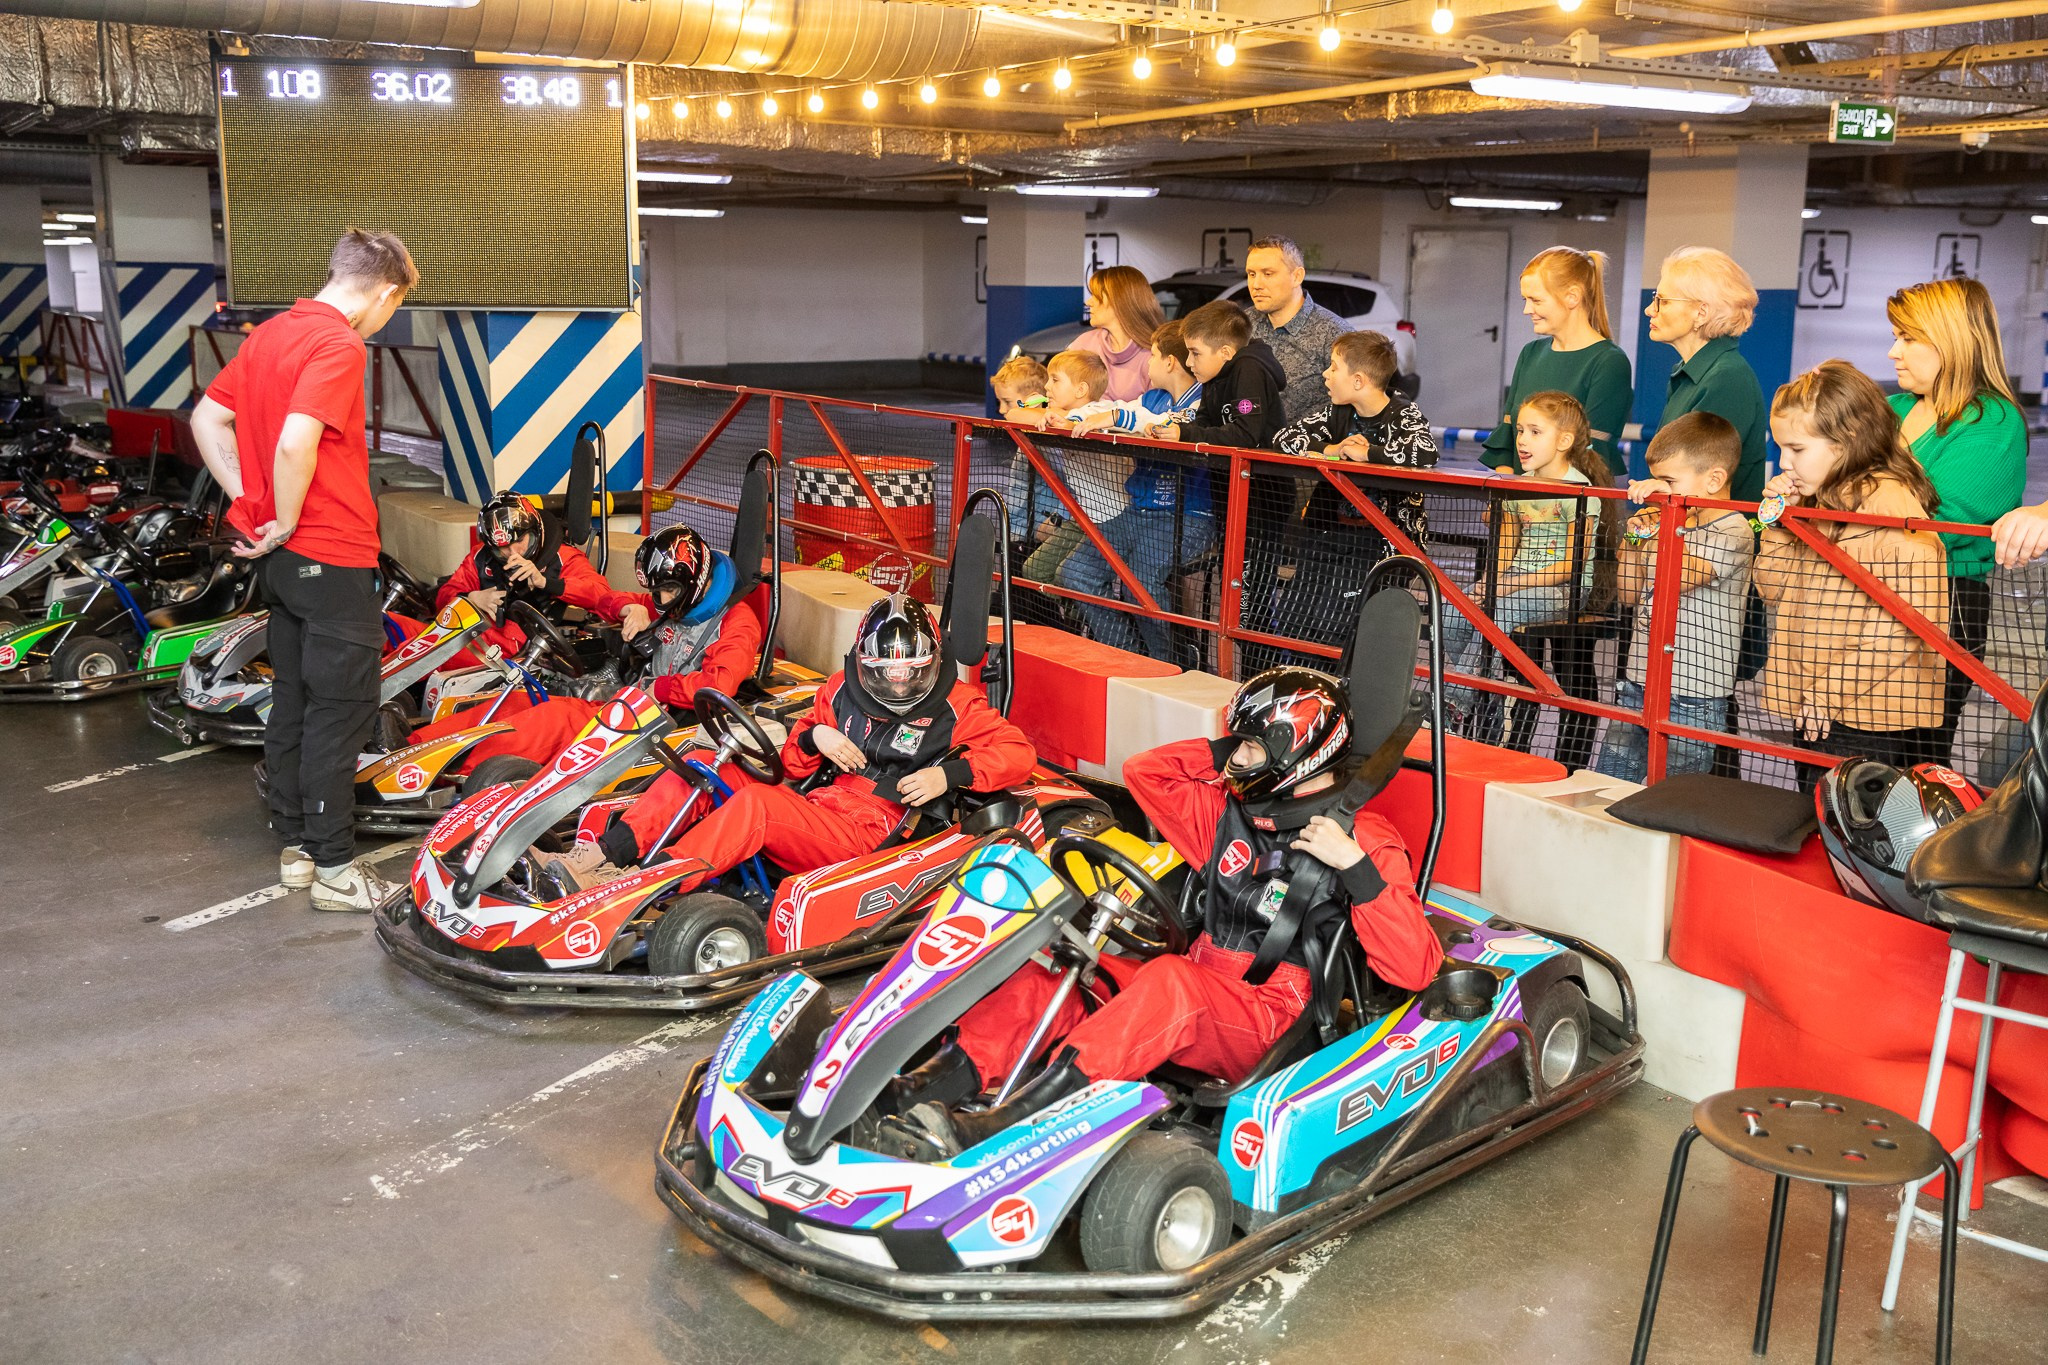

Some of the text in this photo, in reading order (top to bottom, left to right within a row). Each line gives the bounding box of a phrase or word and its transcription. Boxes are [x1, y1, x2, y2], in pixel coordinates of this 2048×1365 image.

[220, 68, 623, 107] 1 108 36.02 38.48 1
[1842, 124, 1860, 135] EXIT
[1296, 722, 1349, 780] Helmet
[549, 876, 642, 926] #k54karting
[568, 928, 597, 953] 54
[919, 923, 980, 968] 54
[813, 1059, 842, 1090] 2
[1336, 1032, 1461, 1135] EVO6
[976, 1090, 1122, 1167] vk.com/k54karting
[1233, 1130, 1263, 1168] 54
[964, 1119, 1093, 1199] #k54karting
[992, 1203, 1034, 1240] 54
